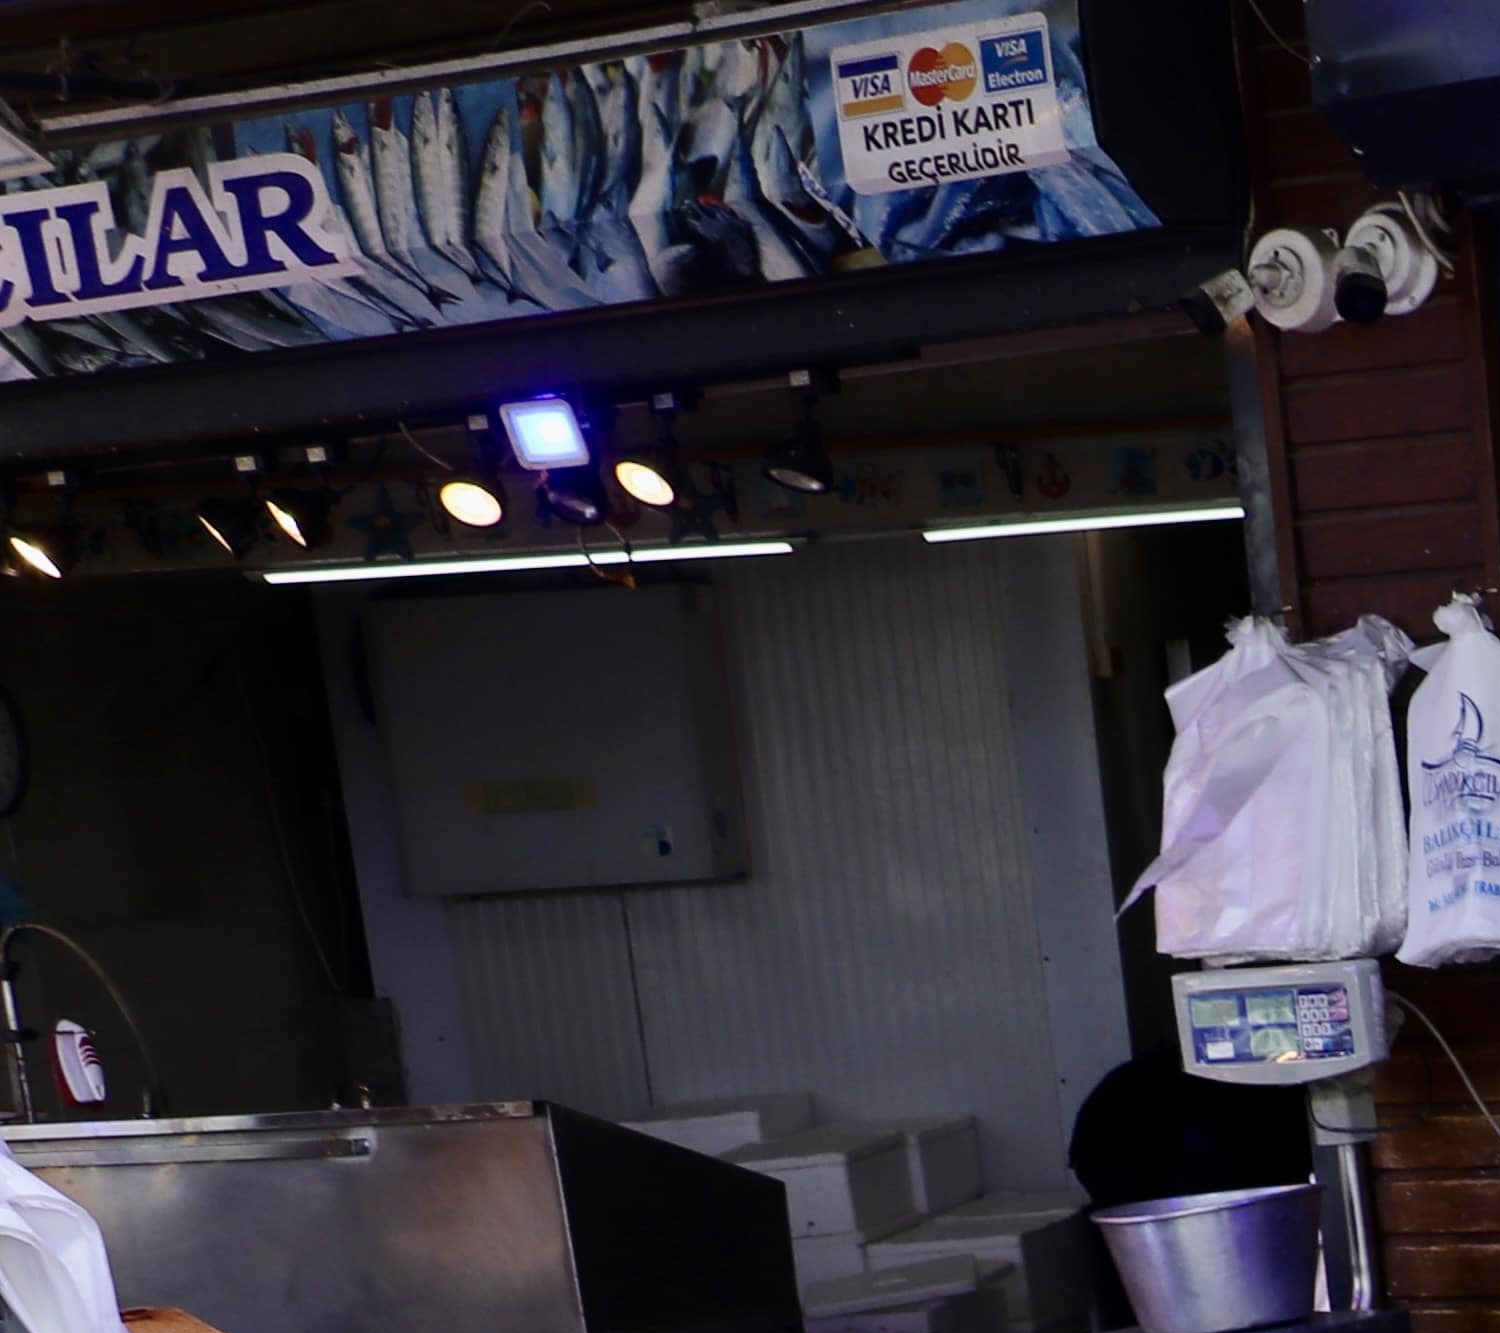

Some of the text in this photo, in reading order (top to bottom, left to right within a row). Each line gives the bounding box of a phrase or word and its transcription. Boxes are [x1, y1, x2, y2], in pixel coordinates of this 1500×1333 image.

[994, 38, 1028, 58] VISA
[851, 74, 892, 98] VISA
[909, 63, 976, 86] MasterCard
[988, 68, 1044, 89] Electron
[863, 98, 1035, 152] KREDİ KARTI
[888, 138, 1025, 184] GEÇERLİDİR
